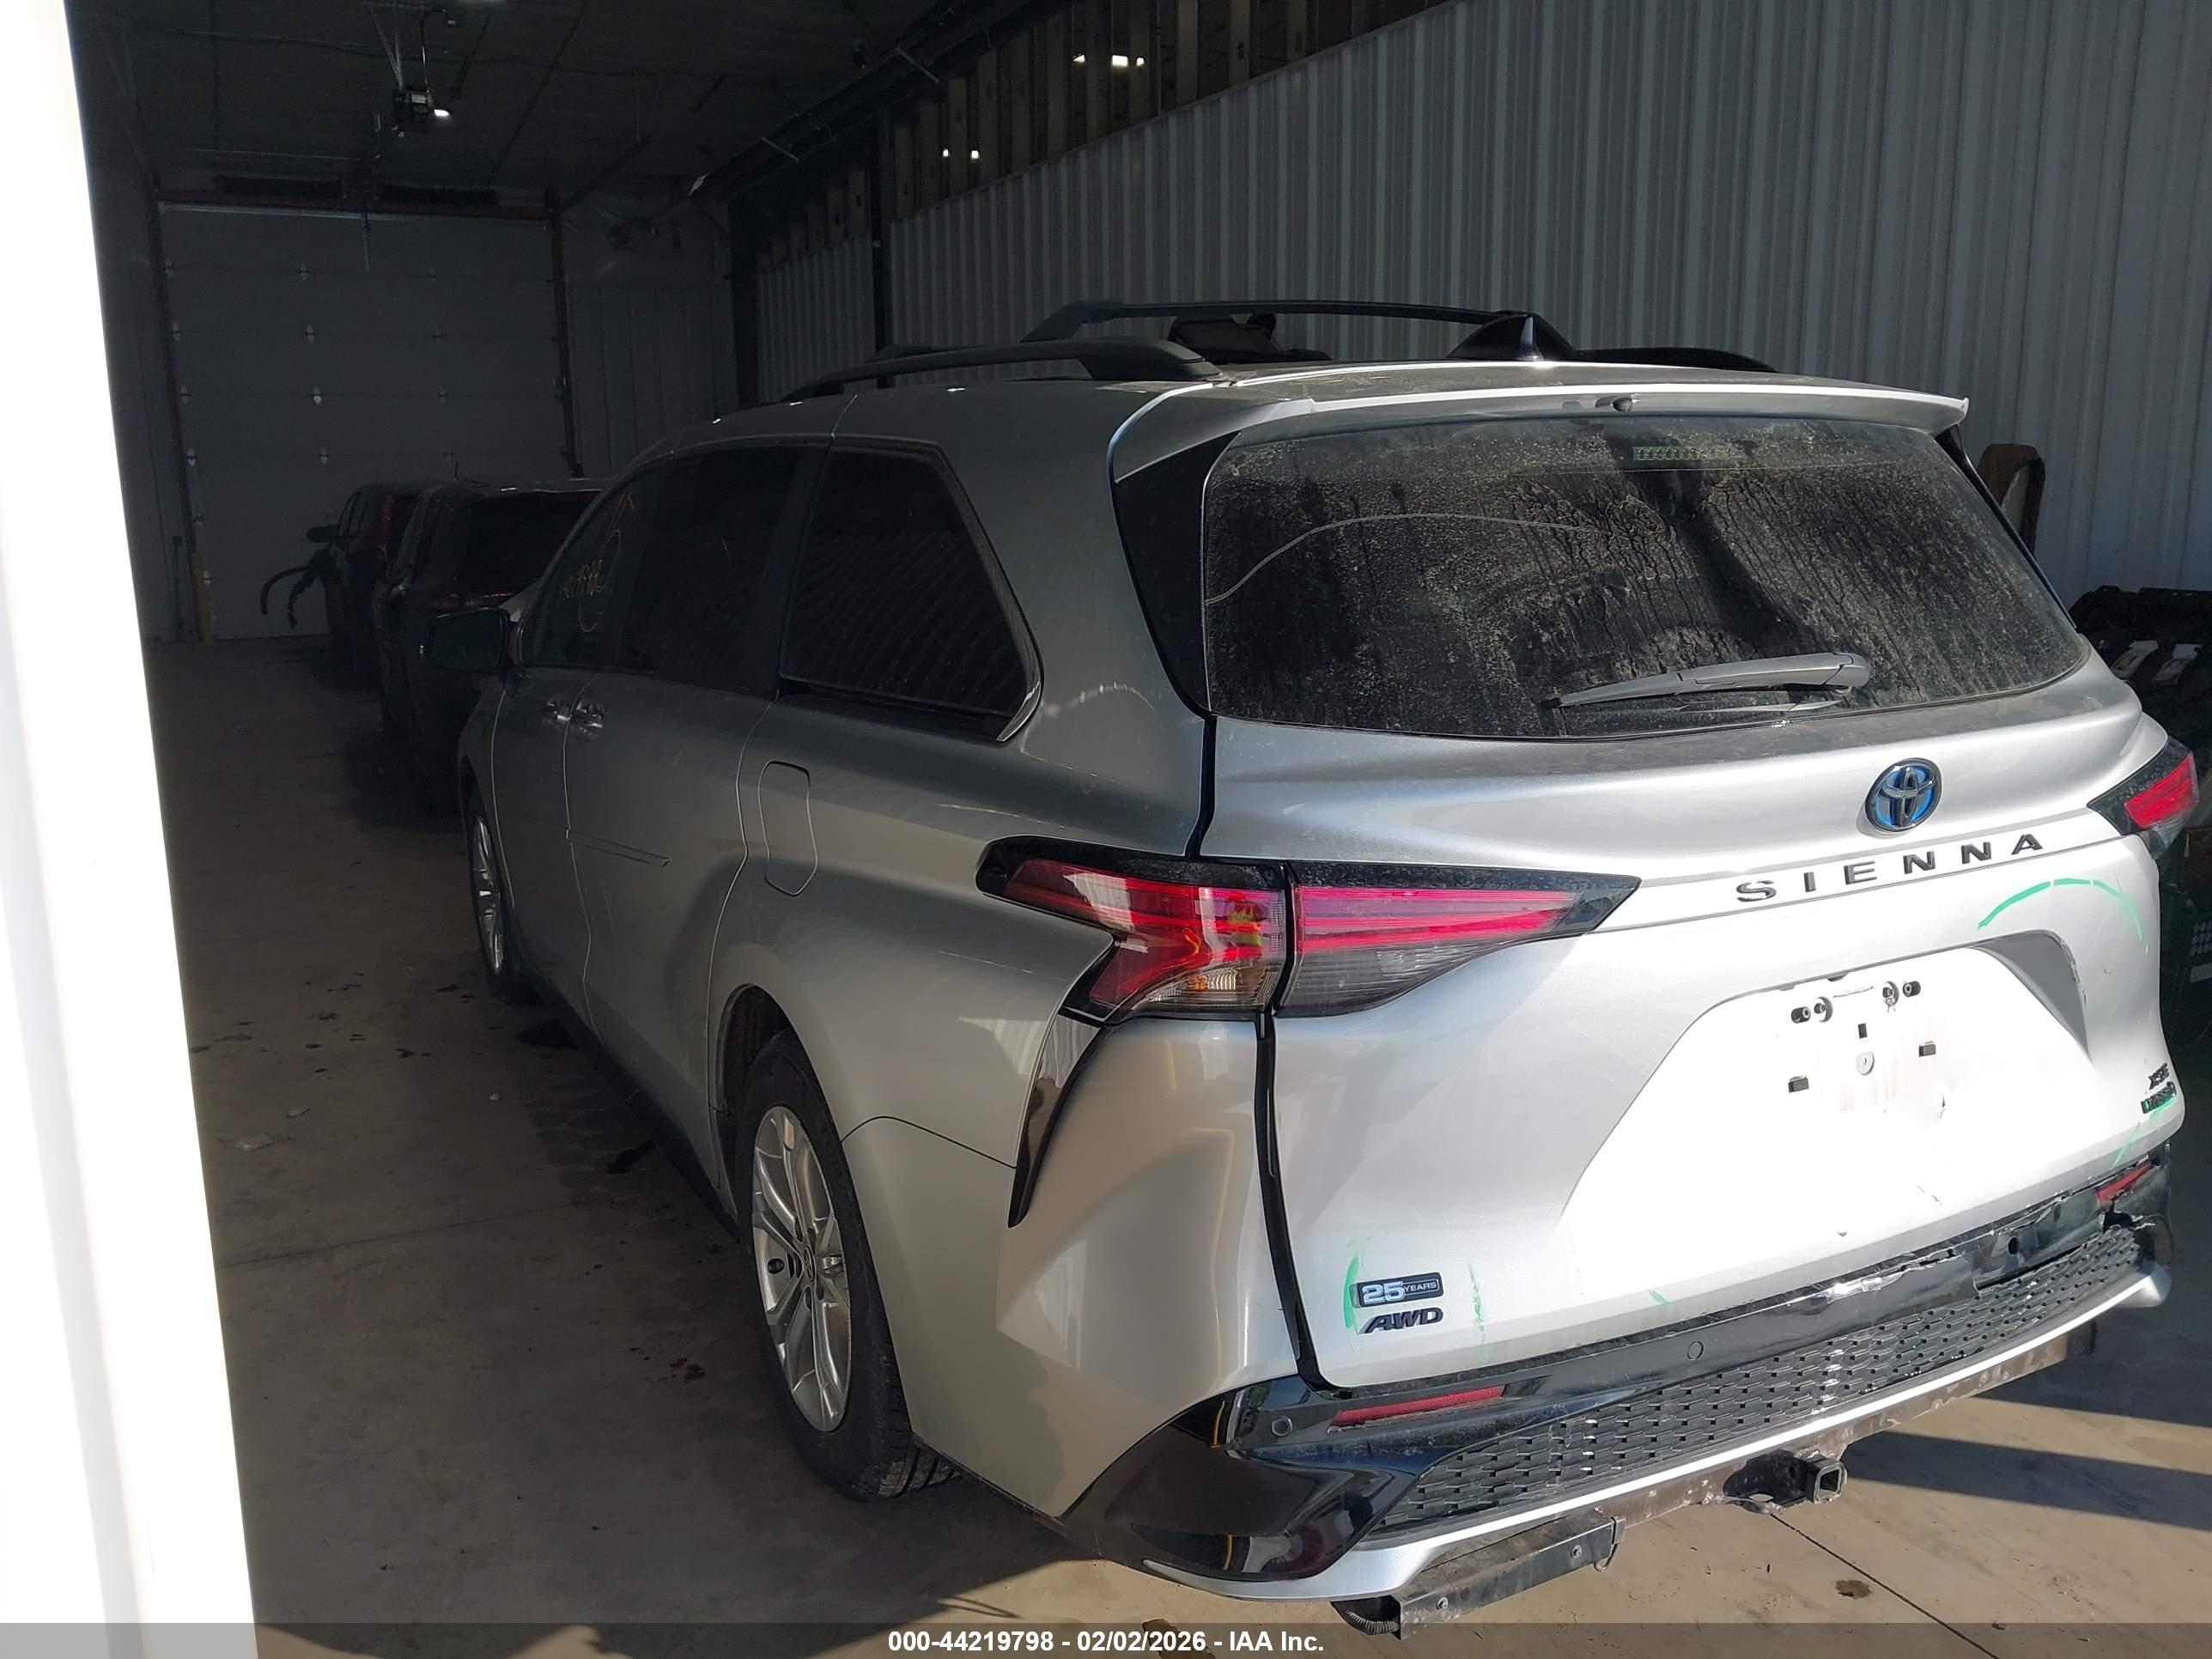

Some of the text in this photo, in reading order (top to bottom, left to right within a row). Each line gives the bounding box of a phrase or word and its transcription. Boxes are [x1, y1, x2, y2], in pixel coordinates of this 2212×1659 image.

[1736, 835, 2044, 902] SIENNA
[1363, 1281, 1437, 1304] 25 YEARS
[1358, 1308, 1443, 1334] AWD
